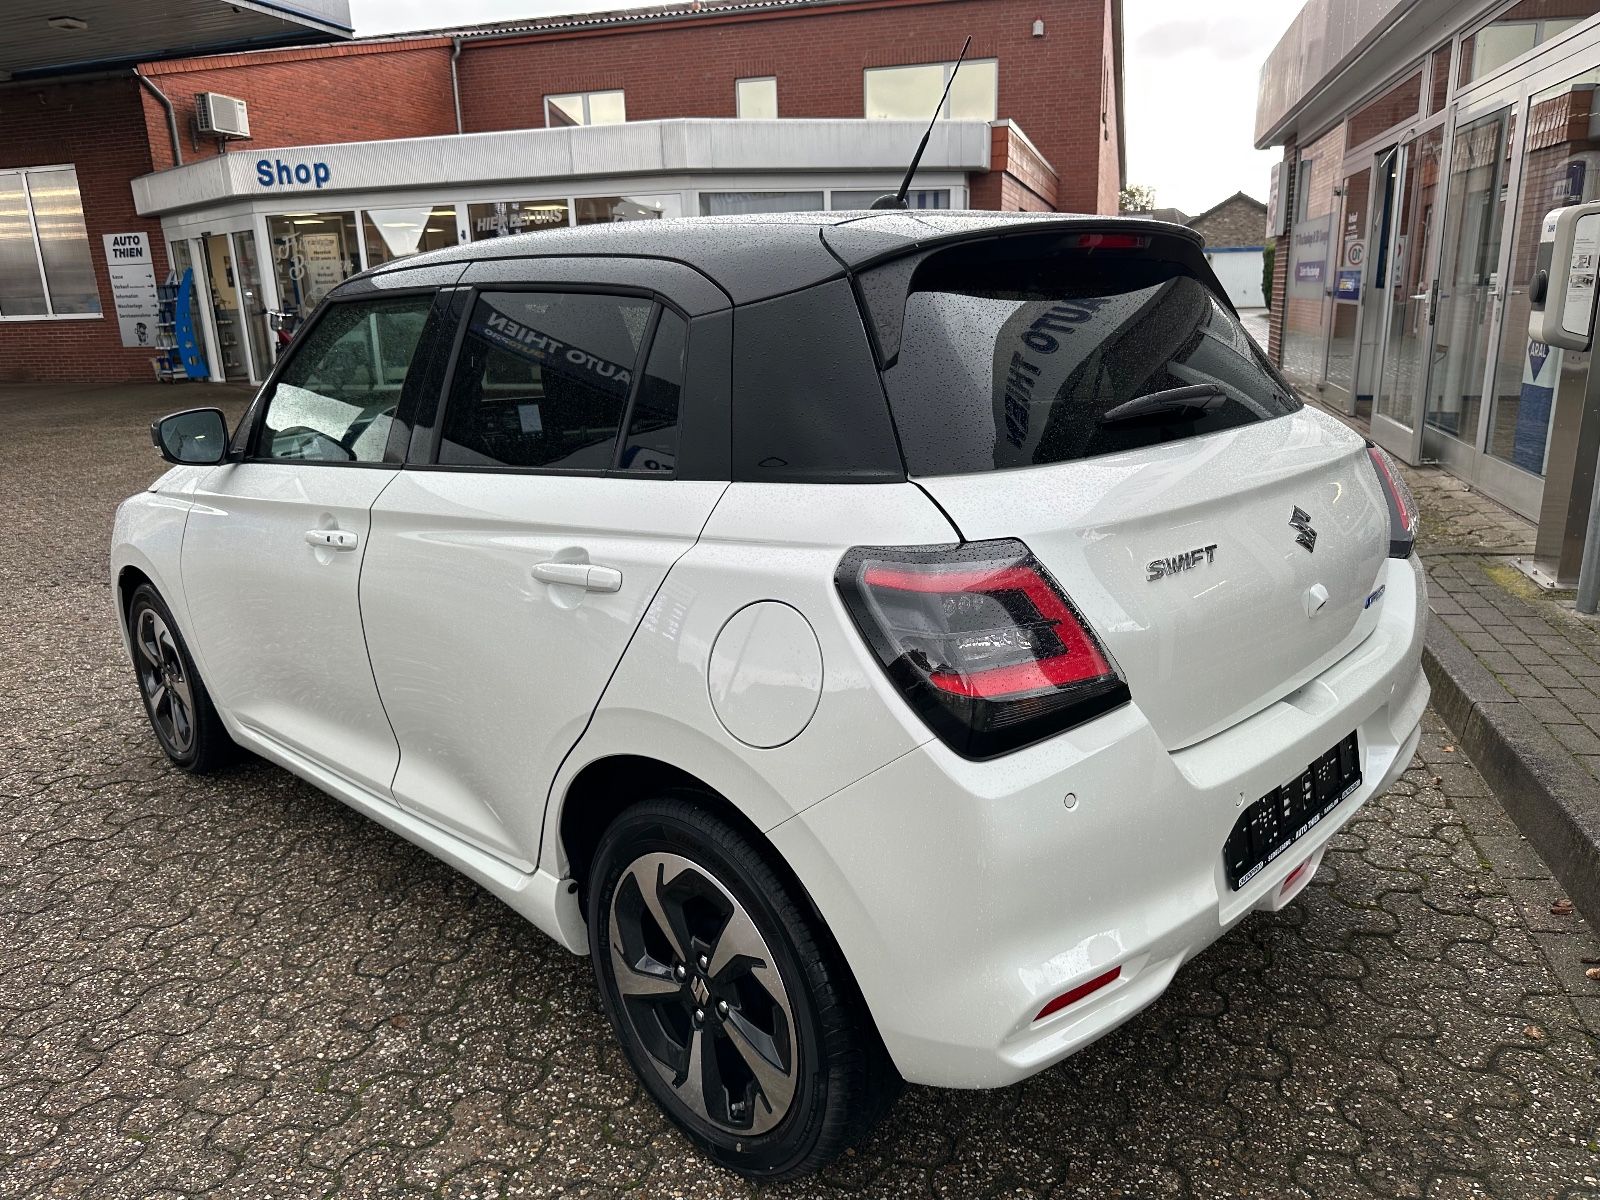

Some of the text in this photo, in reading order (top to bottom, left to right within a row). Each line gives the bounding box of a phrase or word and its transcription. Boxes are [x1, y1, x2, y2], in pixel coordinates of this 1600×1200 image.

[256, 159, 331, 188] Shop
[477, 208, 563, 232] HIER BEI UNS
[112, 235, 141, 247] AUTO
[112, 247, 143, 258] THIEN
[1529, 341, 1547, 358] ARAL
[1145, 543, 1218, 583] SWIFT
